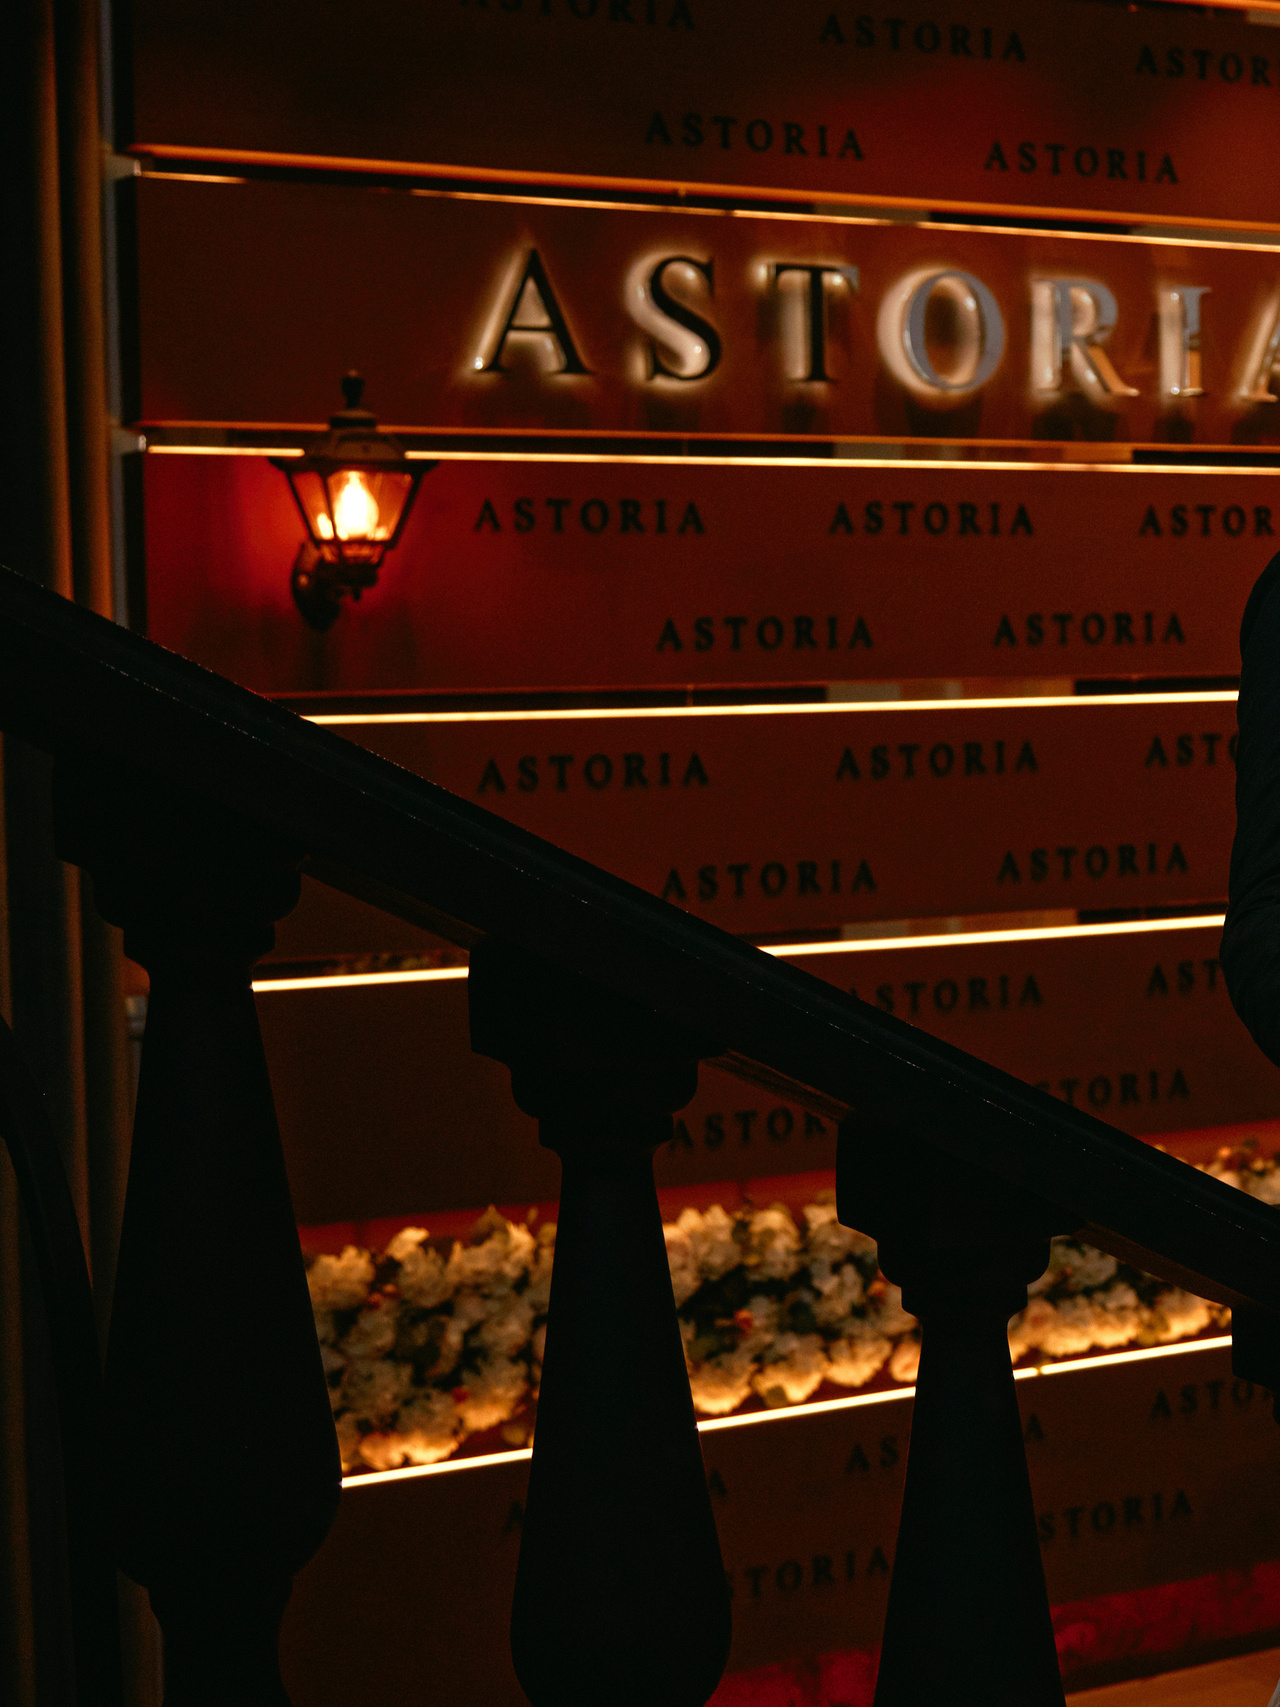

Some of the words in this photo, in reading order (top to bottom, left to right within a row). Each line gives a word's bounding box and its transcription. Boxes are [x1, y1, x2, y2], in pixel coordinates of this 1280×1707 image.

[460, 0, 695, 29] ORIA
[820, 14, 1027, 62] ASTORIA
[645, 112, 864, 160] ASTORIA
[985, 143, 1178, 184] ASTORIA
[475, 499, 704, 533] ASTORIA
[829, 501, 1034, 536] ASTORIA
[656, 615, 873, 652] ASTORIA
[994, 612, 1185, 647] ASTORIA
[477, 752, 709, 793] ASTORIA
[836, 740, 1039, 780] ASTORIA
[662, 860, 877, 900] ASTORIA
[998, 842, 1188, 883] ASTORIA
[850, 974, 1043, 1014] STORIA
[1035, 1068, 1190, 1106] TORIA
[1151, 1379, 1273, 1419] ASTO
[725, 1546, 890, 1598] TORIA
